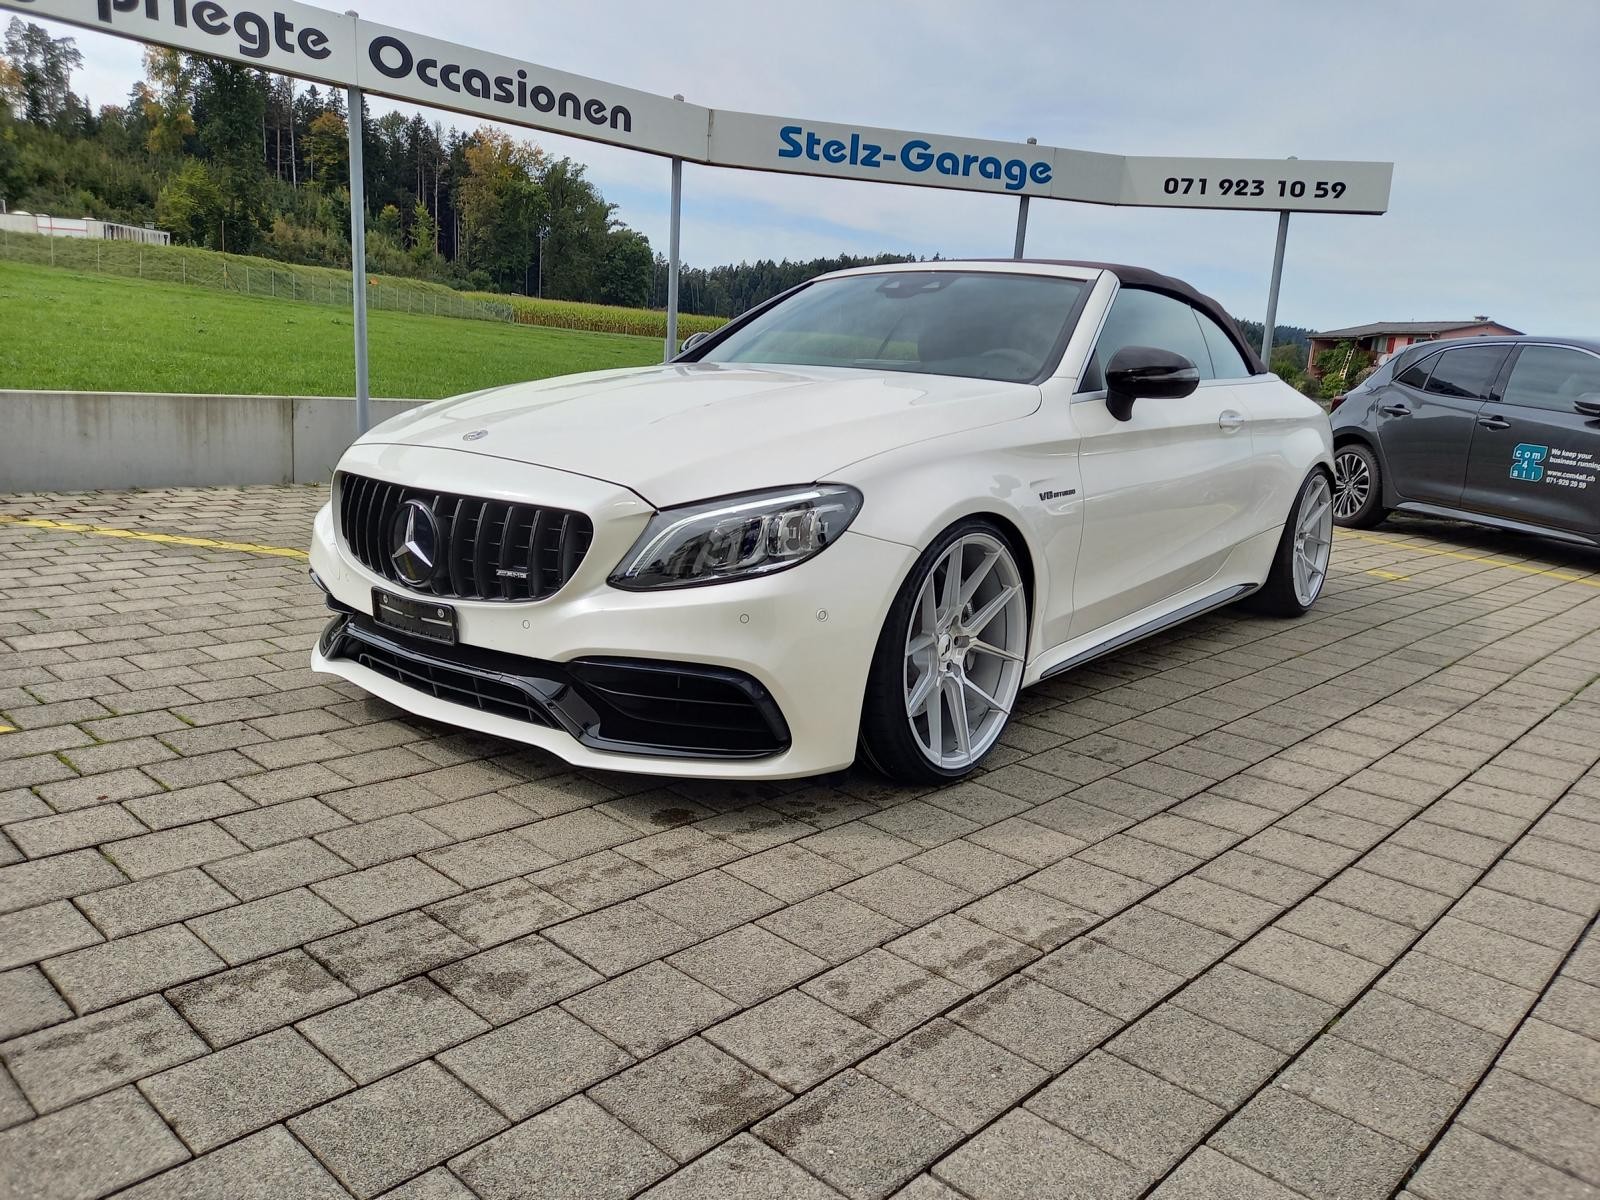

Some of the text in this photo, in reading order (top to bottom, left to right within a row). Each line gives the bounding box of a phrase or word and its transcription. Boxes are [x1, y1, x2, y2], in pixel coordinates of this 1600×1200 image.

[16, 0, 632, 133] plegte Occasionen
[778, 125, 1053, 191] Stelz-Garage
[1163, 177, 1347, 200] 071 923 10 59
[1516, 450, 1541, 460] com
[1551, 448, 1593, 460] We keep your
[1522, 460, 1528, 469] 4
[1549, 456, 1577, 466] business
